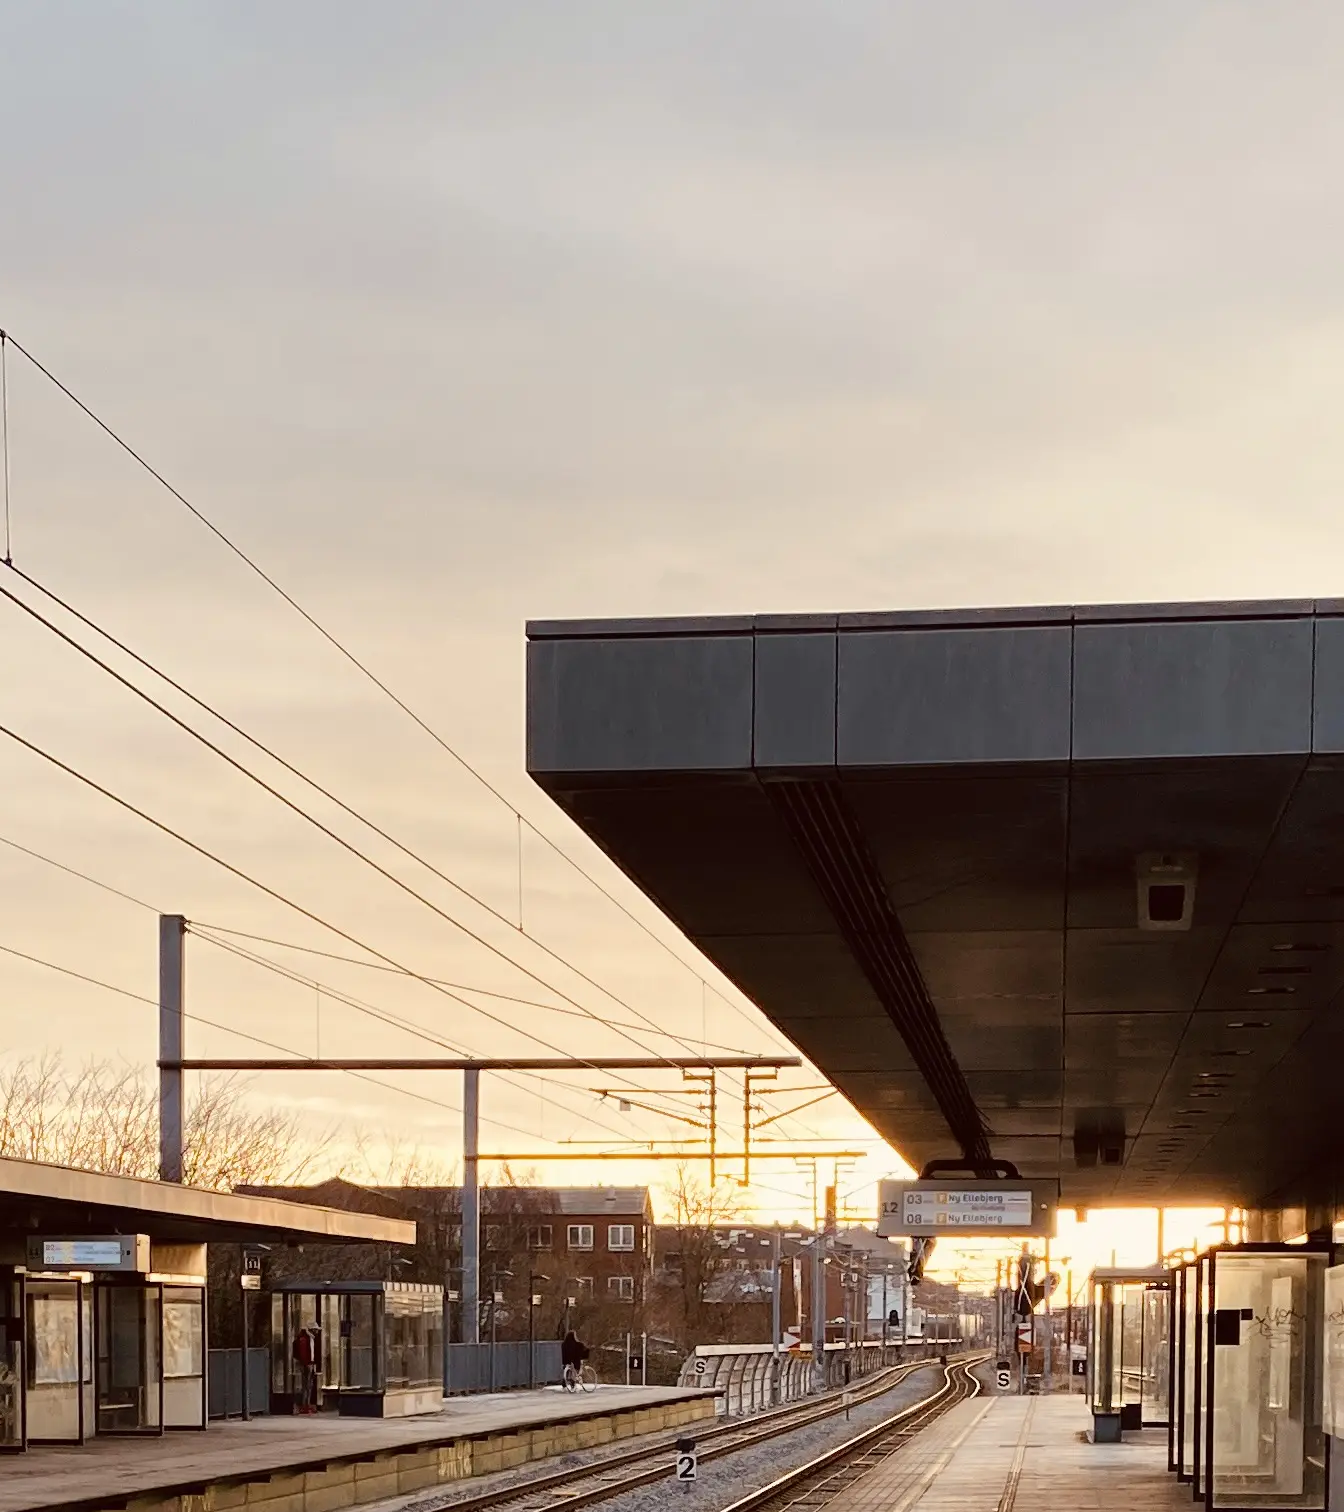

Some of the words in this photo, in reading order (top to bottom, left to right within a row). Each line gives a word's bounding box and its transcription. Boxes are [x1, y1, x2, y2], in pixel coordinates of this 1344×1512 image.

[882, 1202, 899, 1214] 12
[696, 1361, 706, 1374] S
[997, 1372, 1010, 1387] S
[678, 1456, 695, 1479] 2
